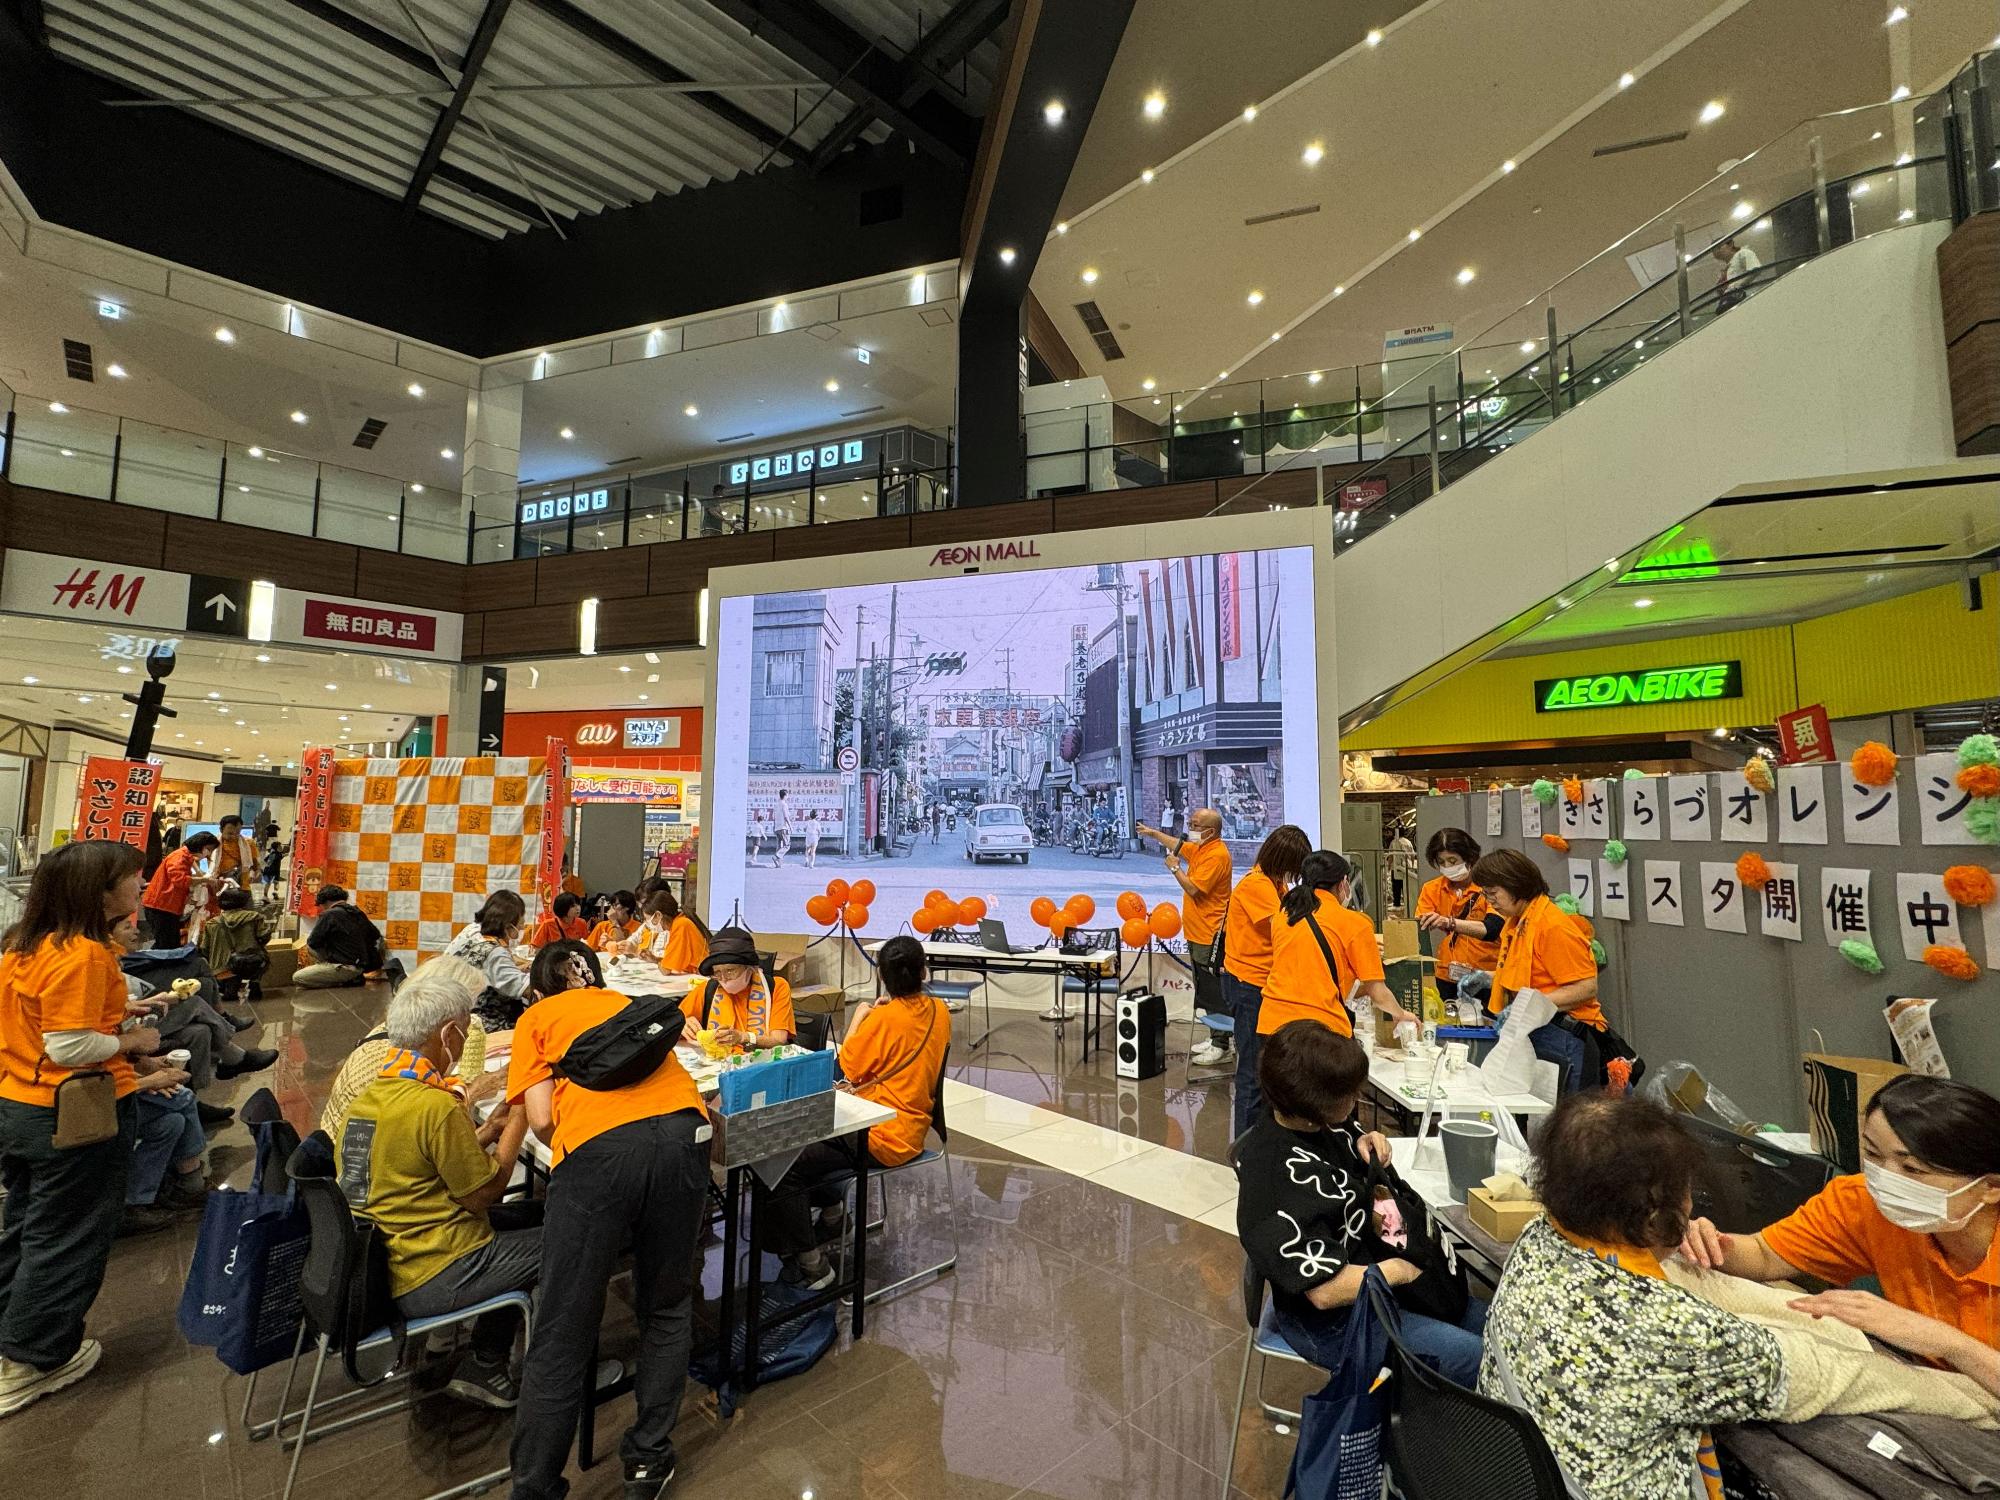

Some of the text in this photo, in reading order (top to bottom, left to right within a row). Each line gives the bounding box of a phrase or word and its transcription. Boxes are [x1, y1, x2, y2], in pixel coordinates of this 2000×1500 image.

[526, 445, 858, 519] DRONE SCHOOL
[987, 540, 1040, 561] MALL
[53, 567, 145, 616] H&M
[325, 611, 418, 641] 無印良品
[1545, 665, 1728, 709] AEONBIKE
[576, 724, 618, 745] au
[120, 767, 154, 848] 認知症に
[1412, 979, 1420, 1017] RAVELER
